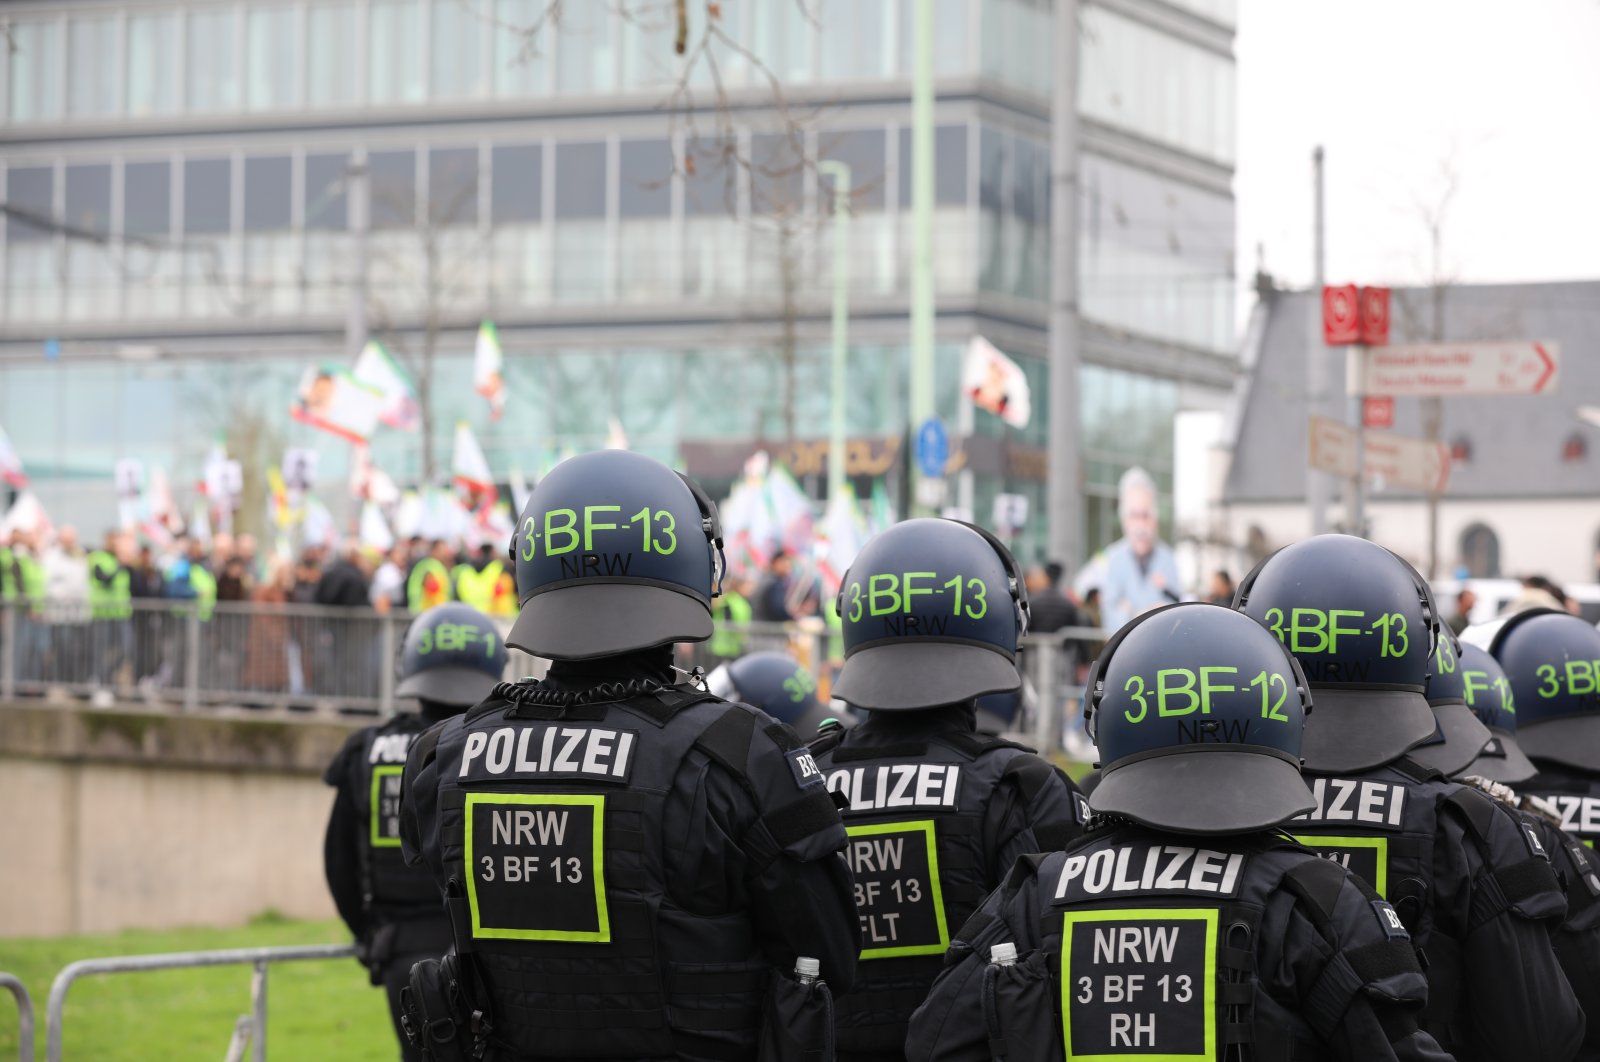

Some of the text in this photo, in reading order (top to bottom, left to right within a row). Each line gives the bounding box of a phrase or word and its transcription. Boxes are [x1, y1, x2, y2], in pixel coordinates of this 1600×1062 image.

[522, 505, 677, 562] 3-BF-13
[560, 552, 632, 579] NRW
[848, 572, 988, 623] 3-BF-13
[883, 615, 948, 637] NRW
[1264, 607, 1409, 658] 3-BF-13
[1124, 666, 1289, 723] 3-BF-12
[1178, 719, 1250, 744] NRW
[459, 727, 634, 778] POLIZEI
[820, 764, 960, 811] OLIZEI
[1291, 778, 1405, 826] IZEI
[492, 810, 568, 846] NRW
[481, 855, 583, 884] 3 BF 13
[1055, 846, 1244, 899] POLIZEI
[891, 878, 922, 904] 13
[1093, 926, 1179, 964] NRW
[1077, 974, 1193, 1004] 3 BF 13
[1110, 1012, 1155, 1047] RH
